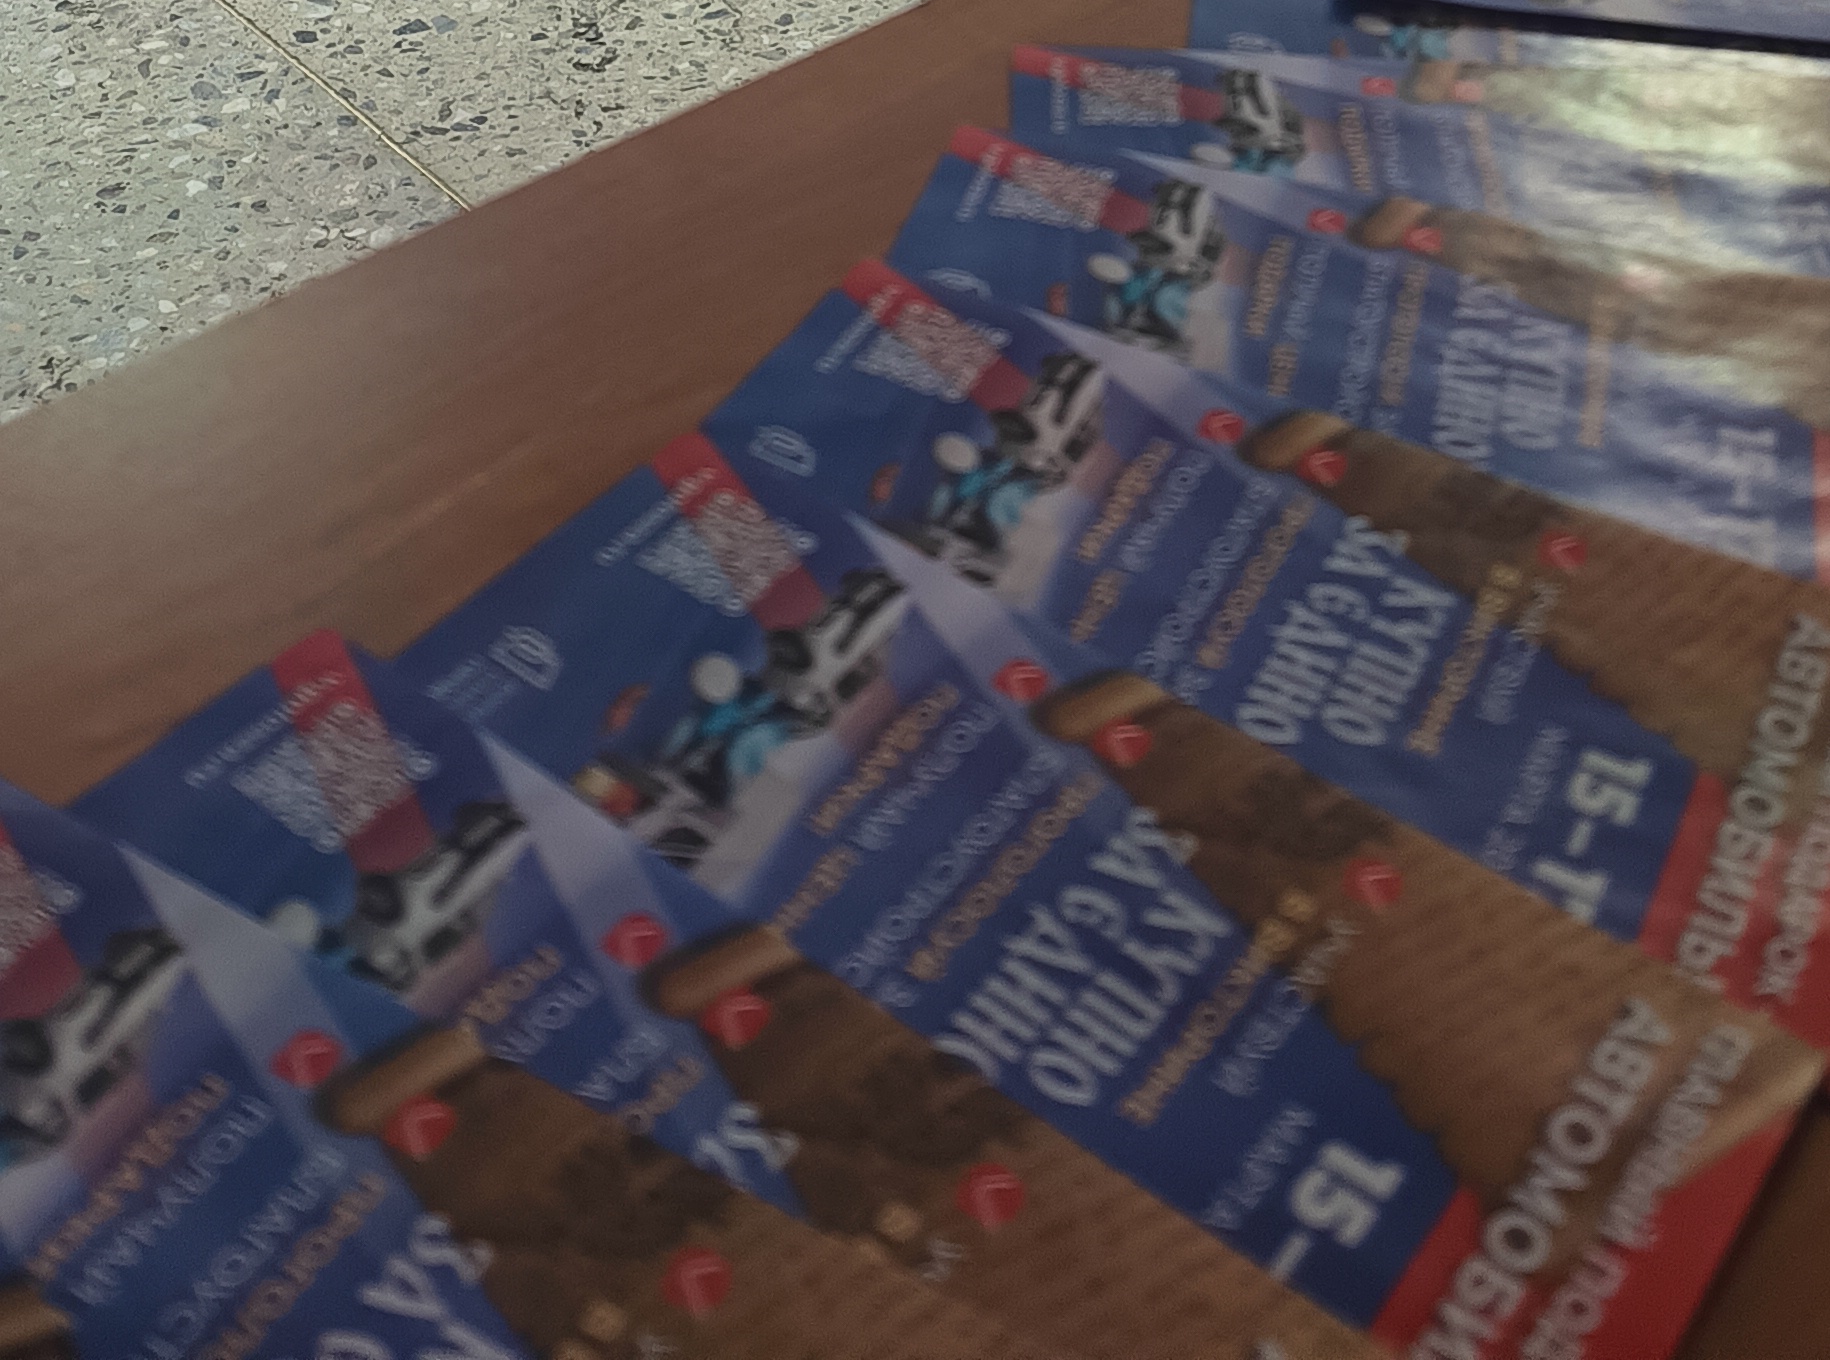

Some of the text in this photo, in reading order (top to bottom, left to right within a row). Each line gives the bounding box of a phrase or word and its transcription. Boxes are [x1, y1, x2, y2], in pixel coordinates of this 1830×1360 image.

[1318, 572, 1459, 747] КУПНО
[808, 682, 960, 836] ПОДАРКИ
[846, 698, 999, 852] ПОЛУЧАЙ
[1087, 805, 1199, 892] ЗА
[906, 770, 1102, 982] ПРОГОЛОСУЙ
[1027, 885, 1234, 1108] КУПНО
[1118, 914, 1300, 1128] ВИКТОРИНЕ
[66, 1092, 276, 1308] ПОЛУЧАЙ
[1601, 1022, 1754, 1252] ГЛАВНЫЙ
[358, 1208, 496, 1322] ЗА
